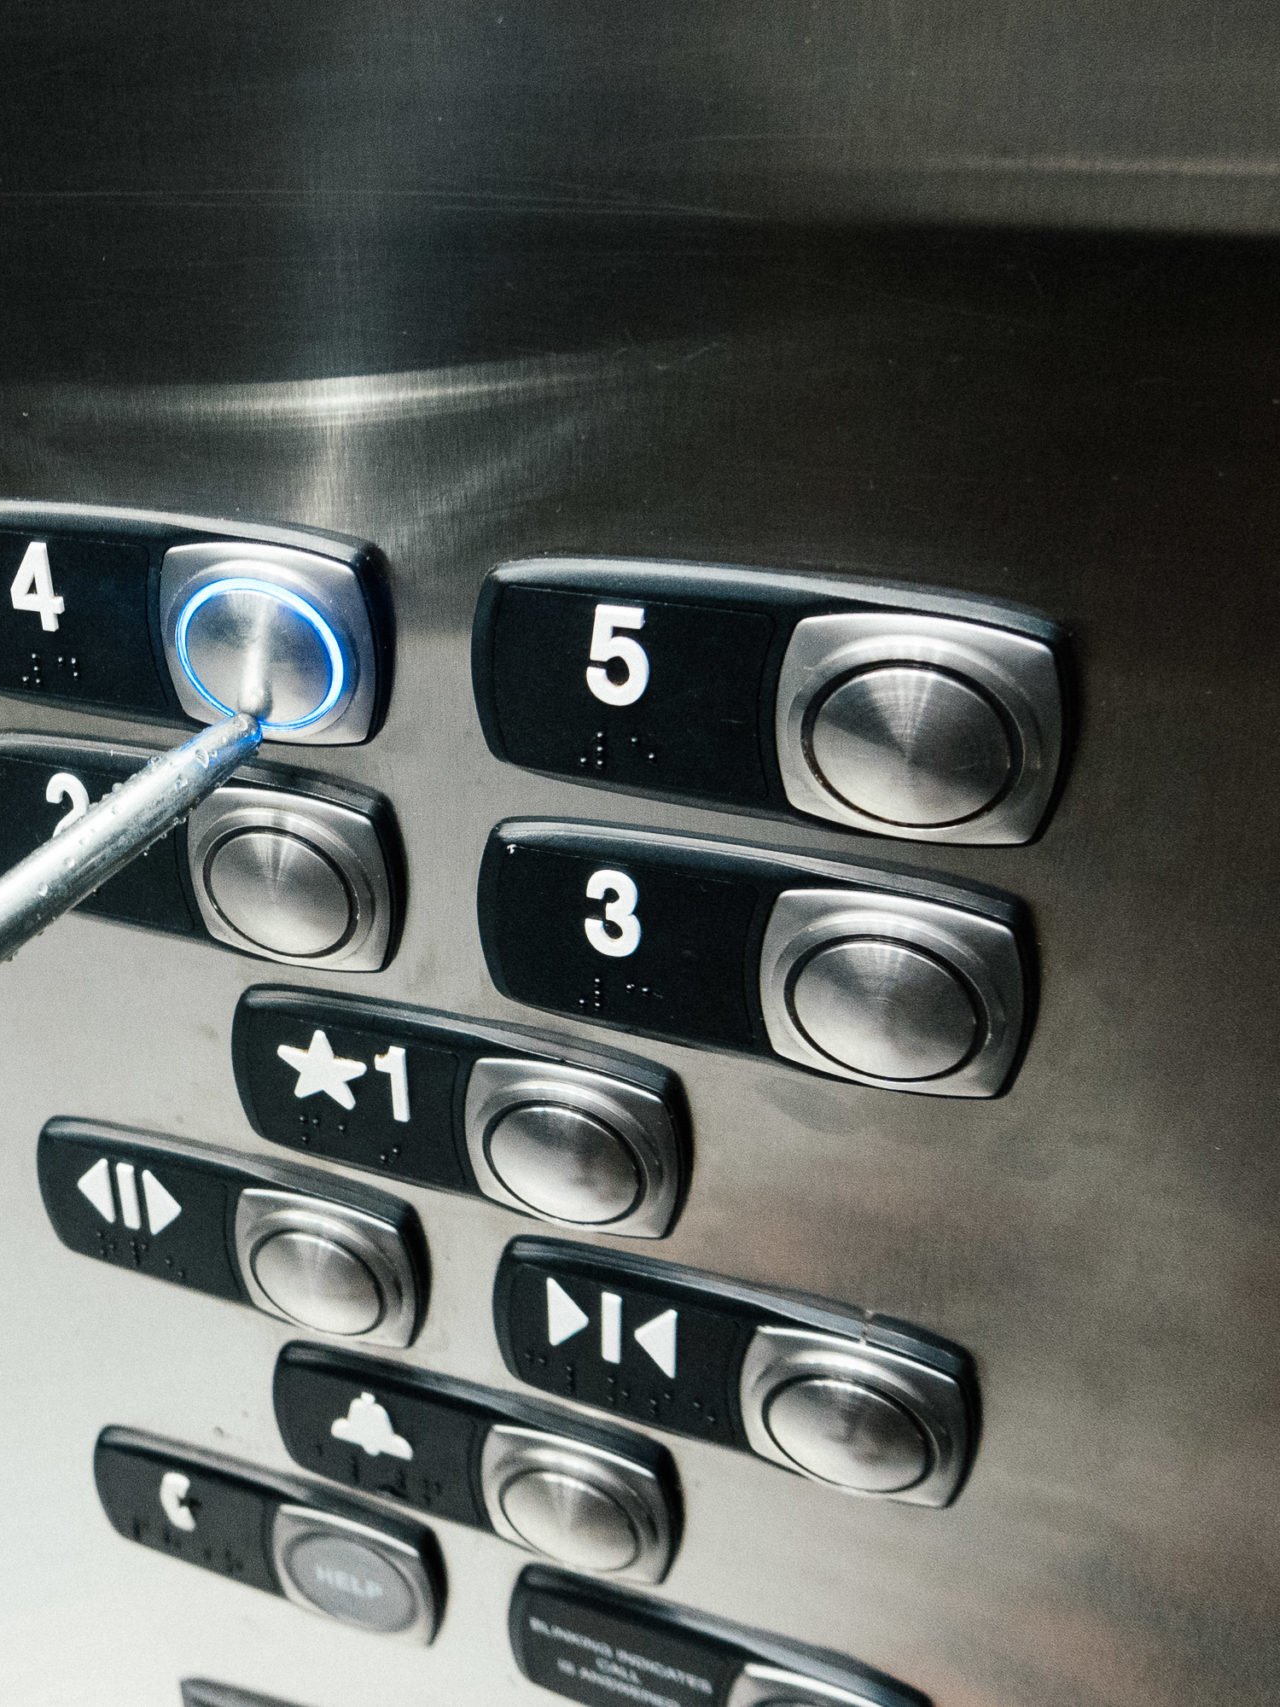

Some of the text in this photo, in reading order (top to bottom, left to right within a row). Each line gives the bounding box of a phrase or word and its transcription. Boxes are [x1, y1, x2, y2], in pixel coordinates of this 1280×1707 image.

[10, 541, 65, 632] 4
[585, 603, 650, 708] 5
[45, 772, 90, 838] 2
[584, 869, 641, 959] 3
[373, 1045, 412, 1123] 1
[315, 1563, 383, 1598] HELP
[528, 1615, 713, 1695] BLINKING INDICATES
[595, 1656, 642, 1686] CALL
